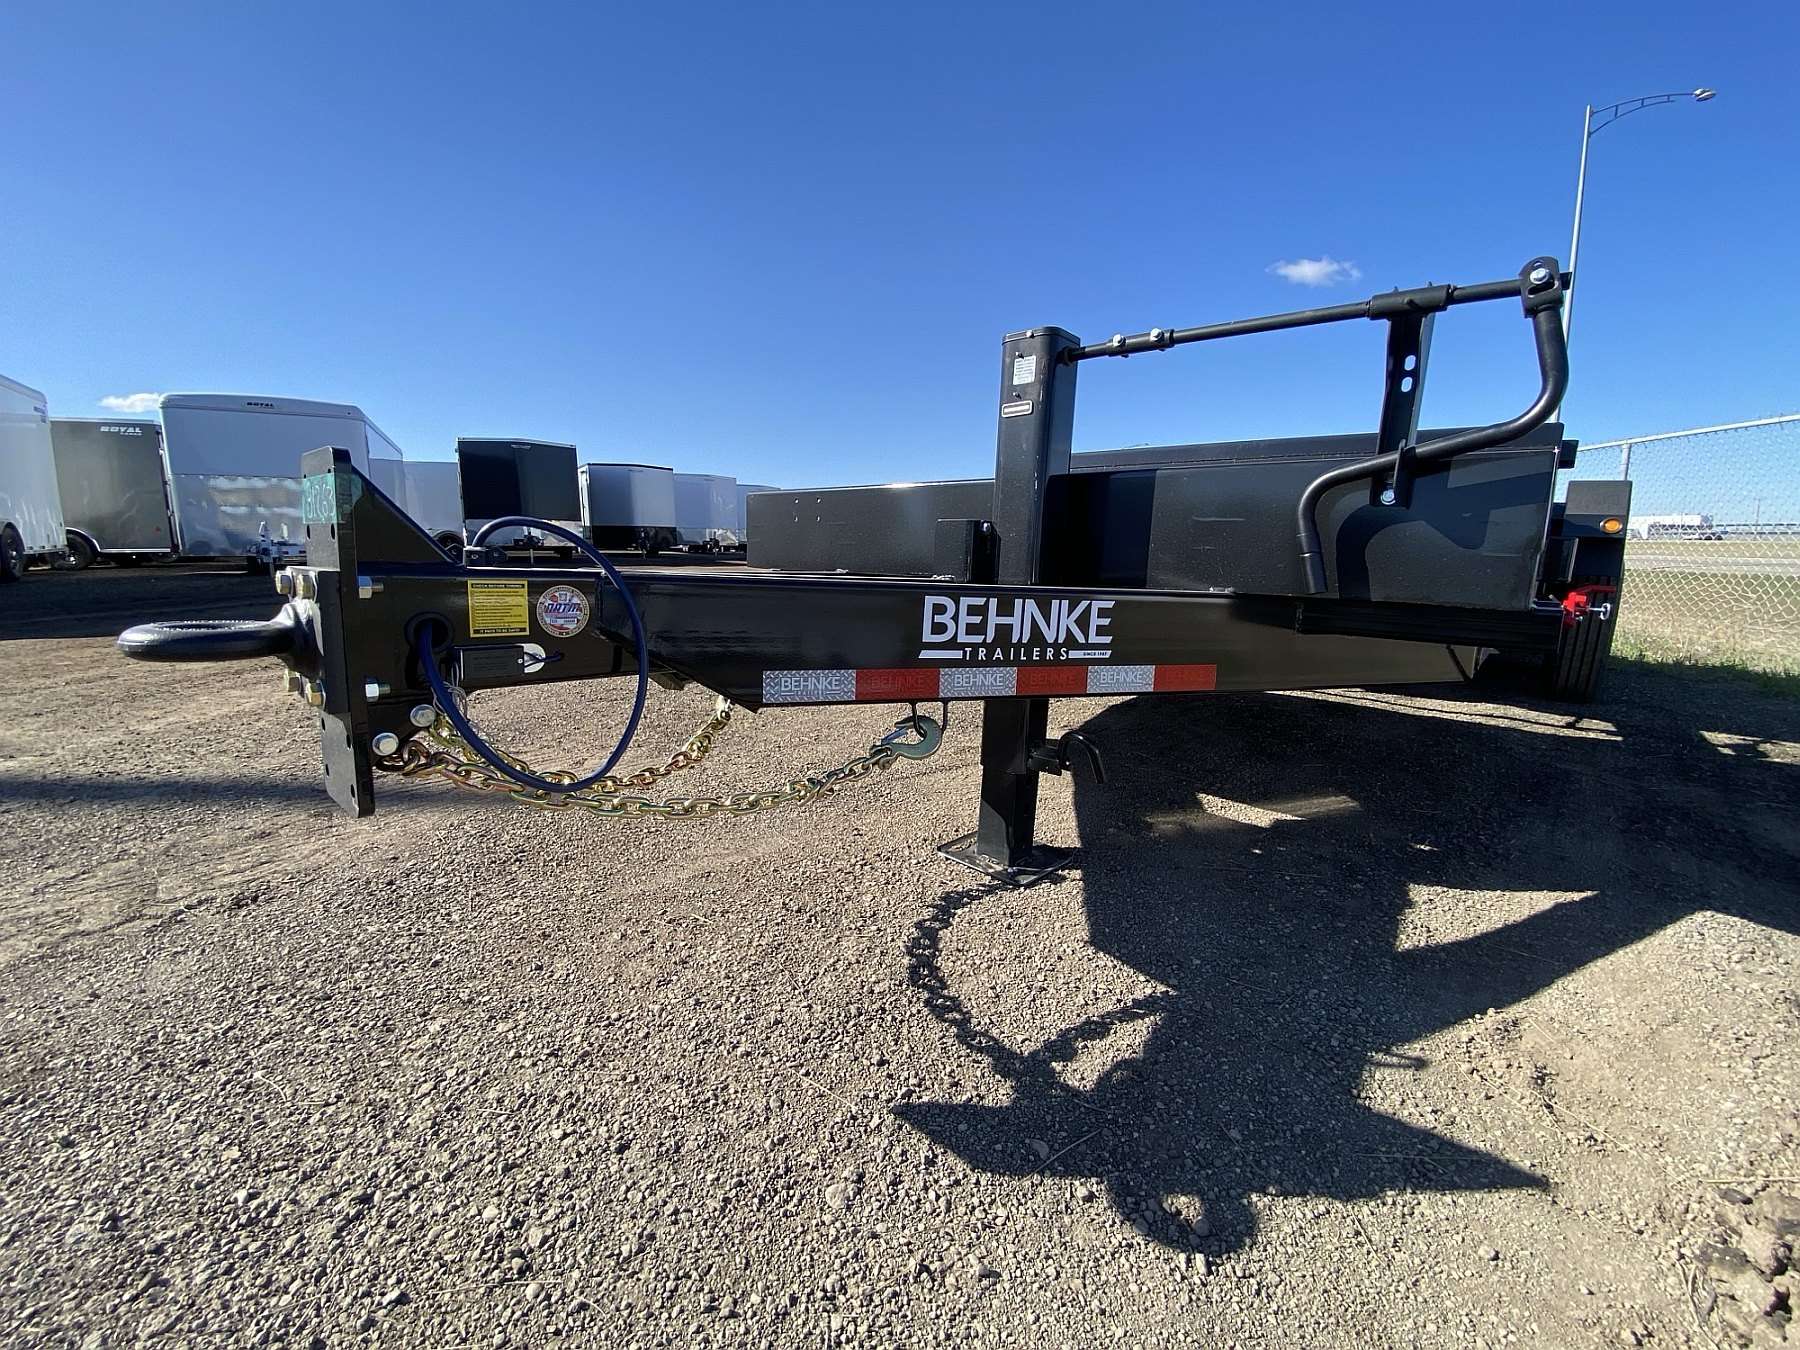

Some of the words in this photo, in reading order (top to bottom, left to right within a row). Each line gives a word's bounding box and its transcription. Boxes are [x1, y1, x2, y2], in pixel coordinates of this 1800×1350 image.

[922, 595, 1115, 643] BEHNKE
[964, 647, 1068, 661] TRAILERS
[781, 676, 841, 690] BEHNKE
[954, 673, 1004, 687] BEHNKE
[1100, 671, 1143, 683] BEHNKE
